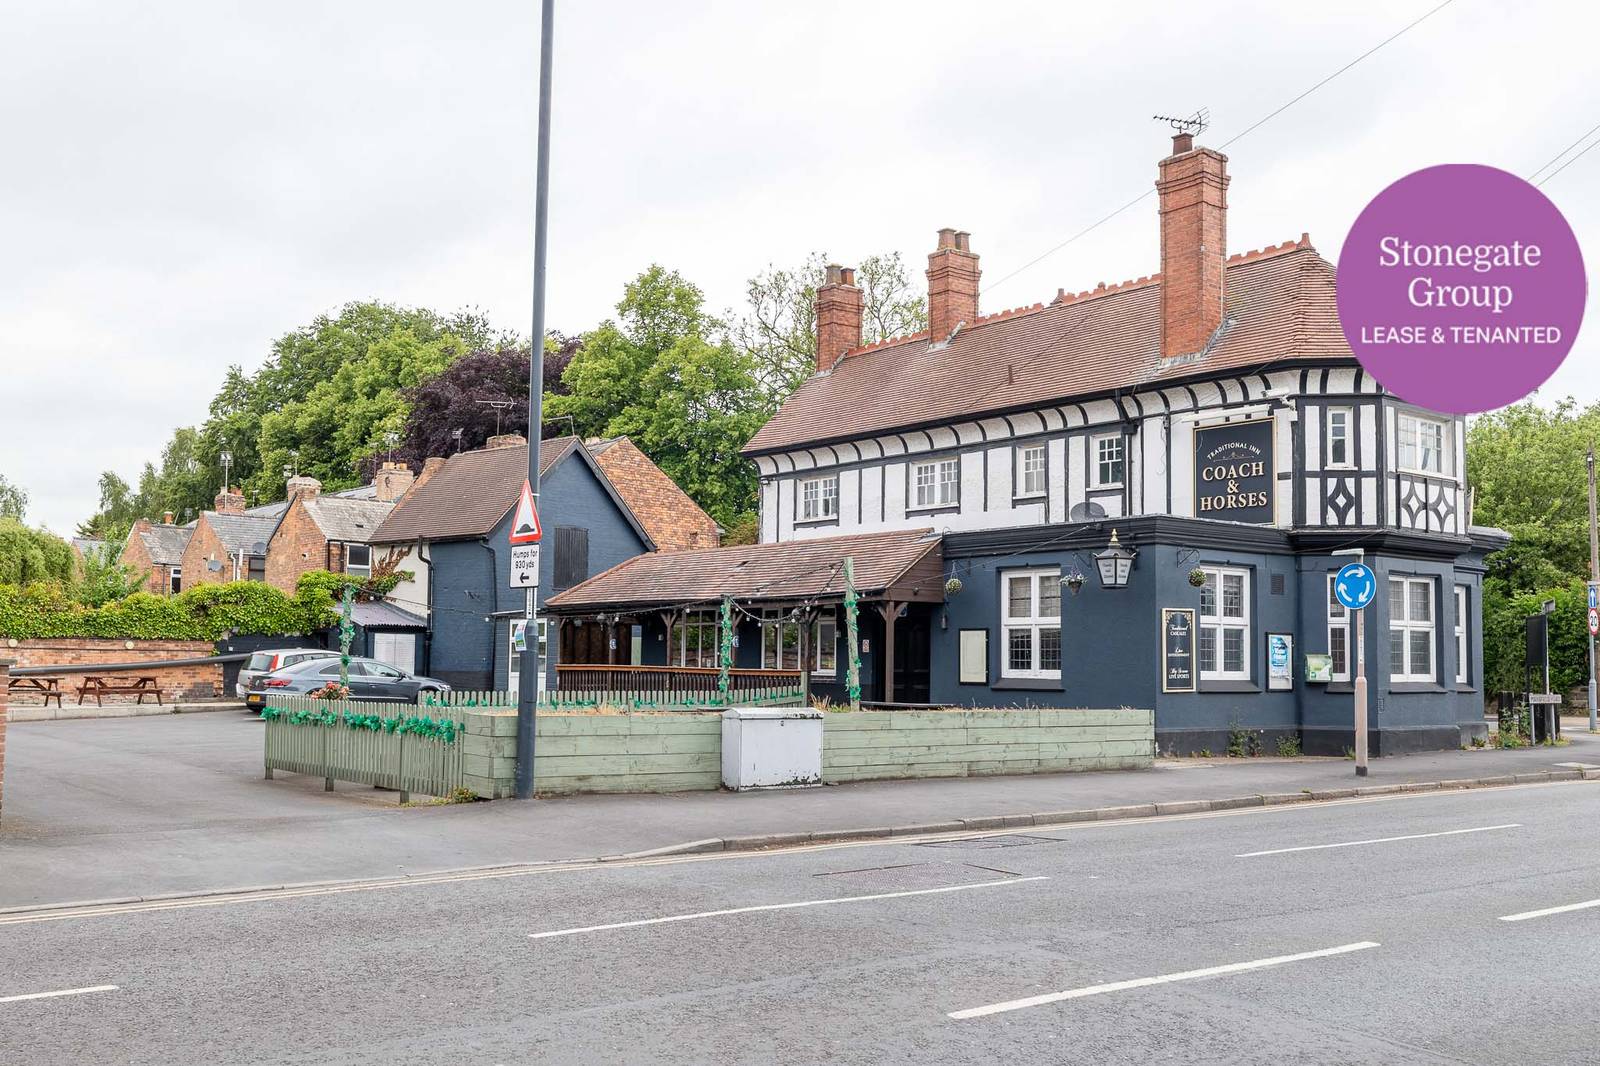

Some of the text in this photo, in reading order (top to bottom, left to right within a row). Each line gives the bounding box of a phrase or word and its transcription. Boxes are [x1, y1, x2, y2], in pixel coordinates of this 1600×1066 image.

[1207, 442, 1261, 460] TRADITIONAL INN
[1202, 461, 1264, 481] COACH
[1227, 479, 1239, 493] &
[1200, 491, 1267, 511] HORSES
[513, 549, 538, 558] Humps for
[515, 560, 535, 570] 930 yds
[1590, 616, 1597, 626] 20
